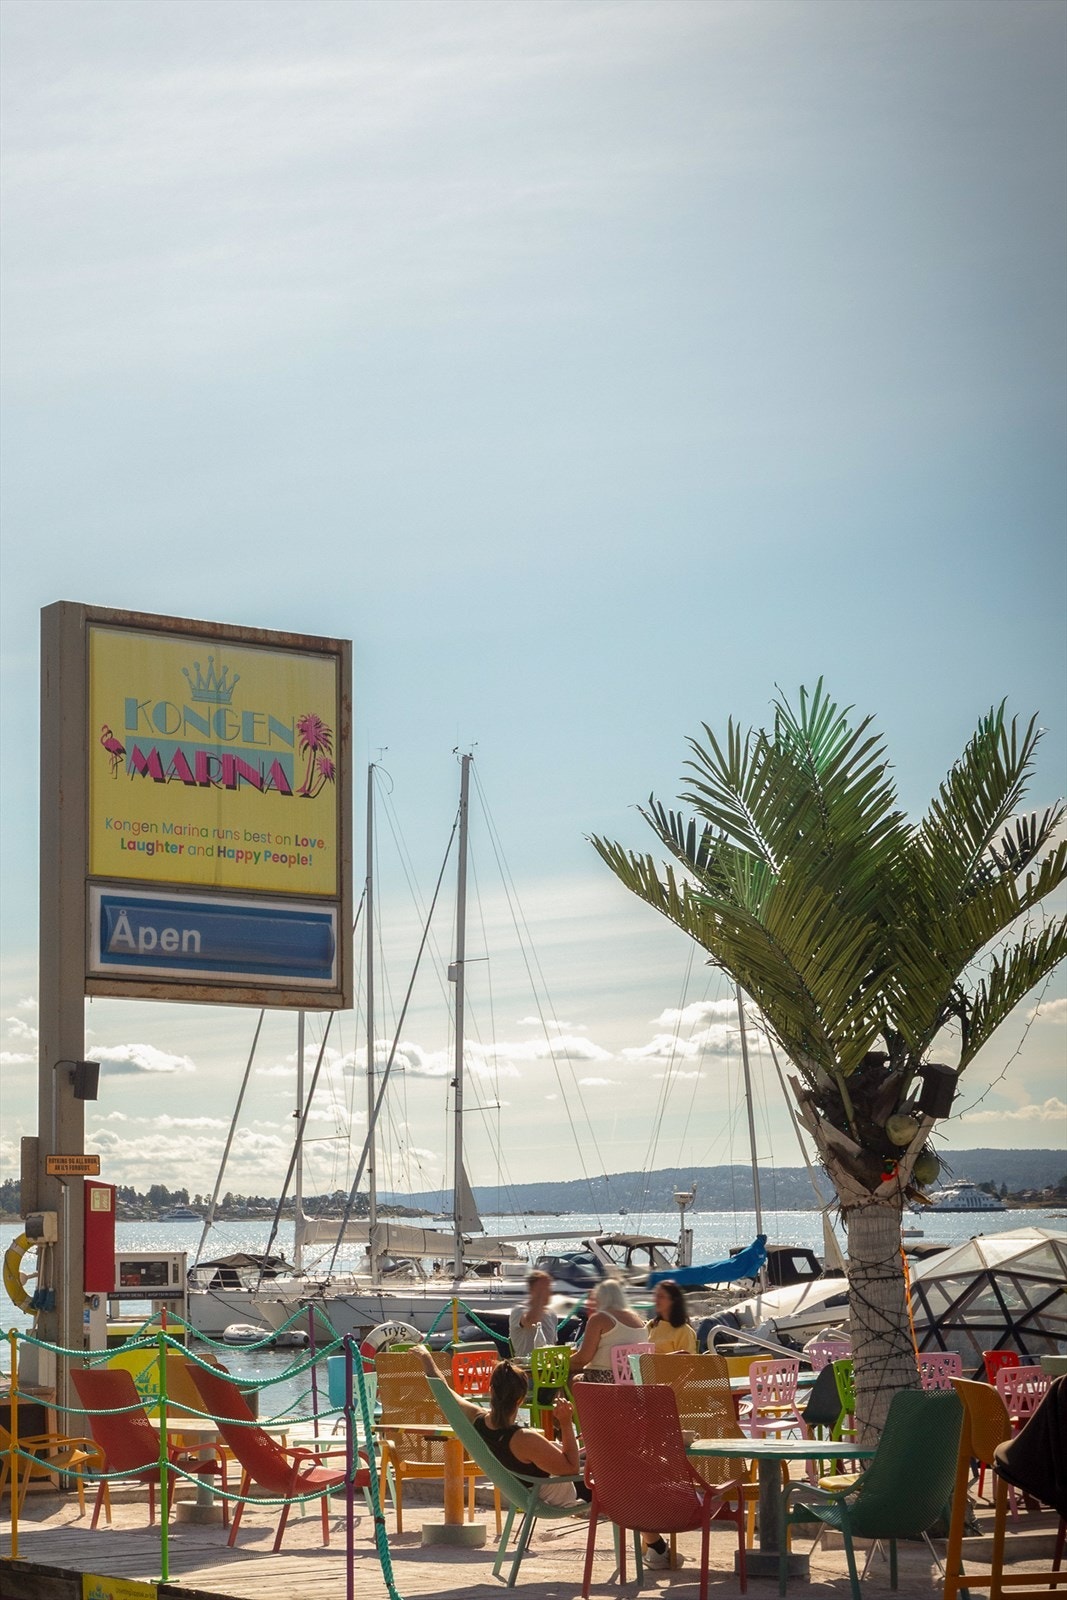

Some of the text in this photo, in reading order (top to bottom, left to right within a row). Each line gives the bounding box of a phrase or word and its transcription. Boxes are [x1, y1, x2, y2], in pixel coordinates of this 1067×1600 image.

[125, 697, 295, 748] KONGEN
[127, 743, 293, 796] MARINA
[105, 817, 327, 850] Kongen Marina runs best on Love,
[121, 838, 312, 868] Laughter and Happy People!
[108, 909, 201, 954] Åpen
